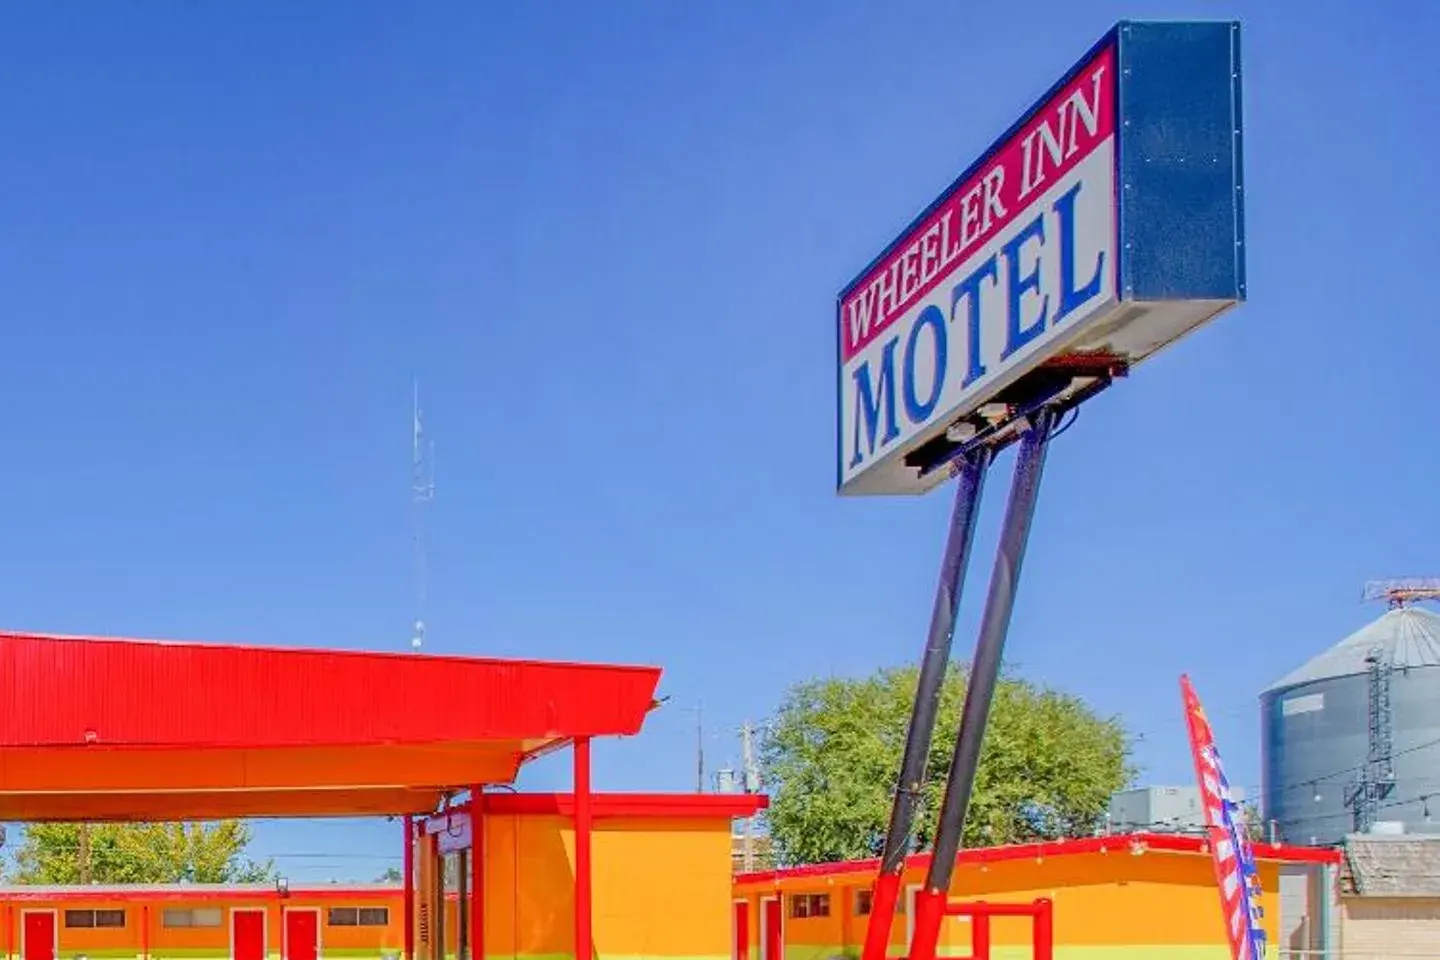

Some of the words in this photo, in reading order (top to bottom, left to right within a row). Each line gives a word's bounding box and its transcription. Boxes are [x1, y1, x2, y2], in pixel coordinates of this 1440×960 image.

[848, 168, 1009, 348] WHEELER
[1017, 66, 1105, 202] INN
[849, 181, 1105, 469] MOTEL
